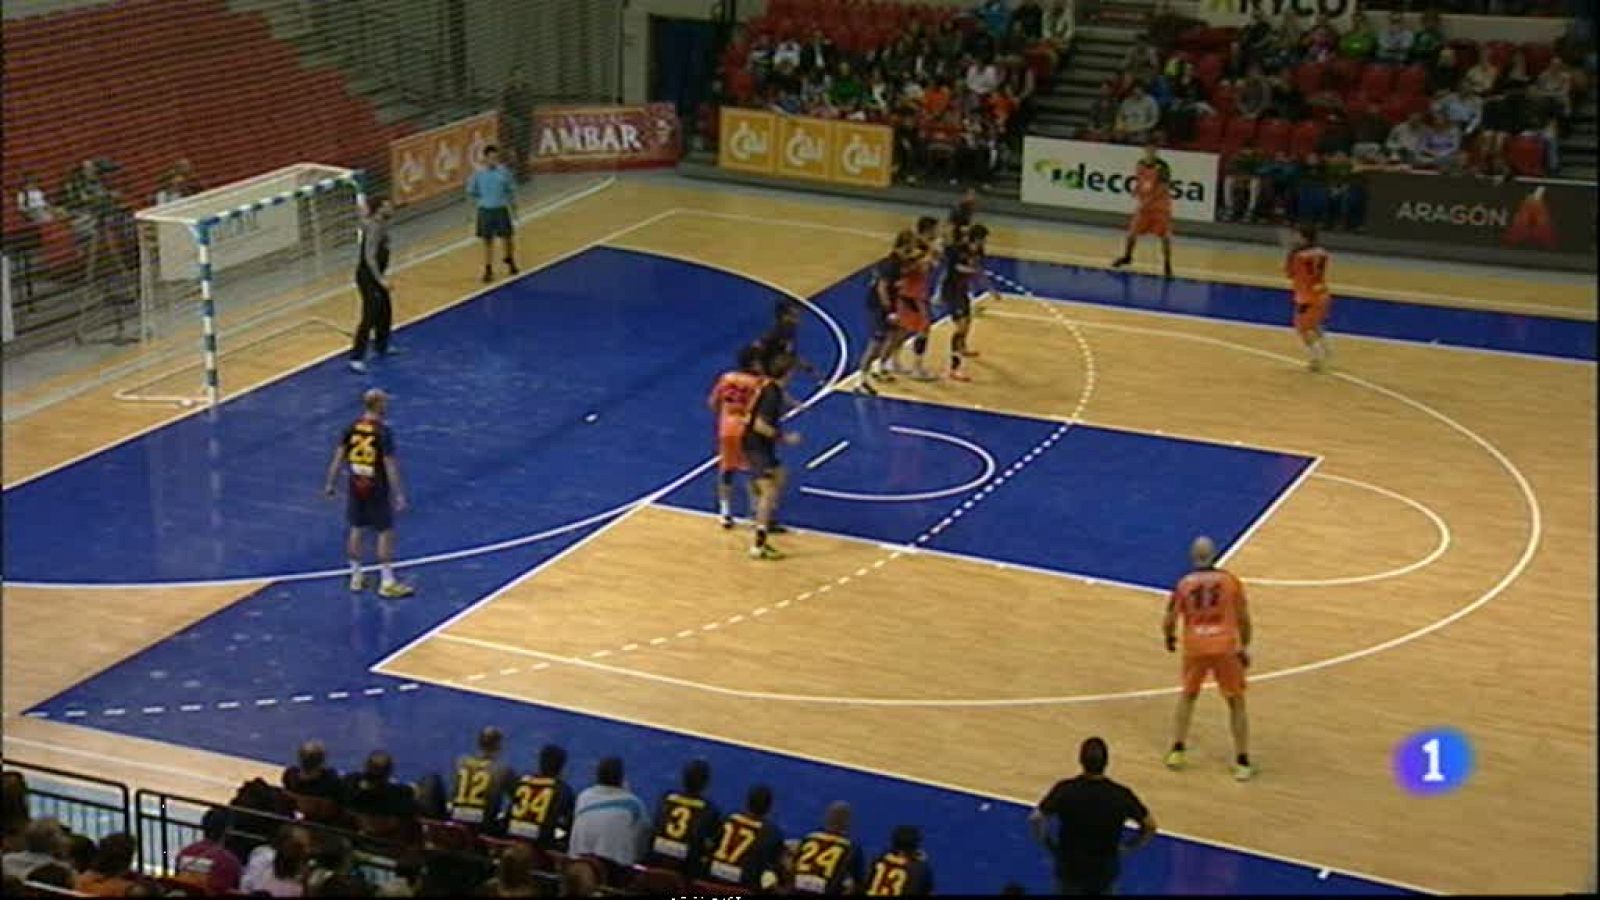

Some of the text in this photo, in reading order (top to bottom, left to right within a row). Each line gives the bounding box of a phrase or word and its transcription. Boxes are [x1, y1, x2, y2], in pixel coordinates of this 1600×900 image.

[538, 122, 643, 157] AMBAR
[1396, 199, 1508, 227] ARAGÓN
[349, 434, 376, 465] 26
[454, 767, 491, 804] 12
[512, 784, 555, 824] 34
[665, 806, 692, 838] 3
[713, 821, 756, 864] 17
[796, 839, 845, 879] 24
